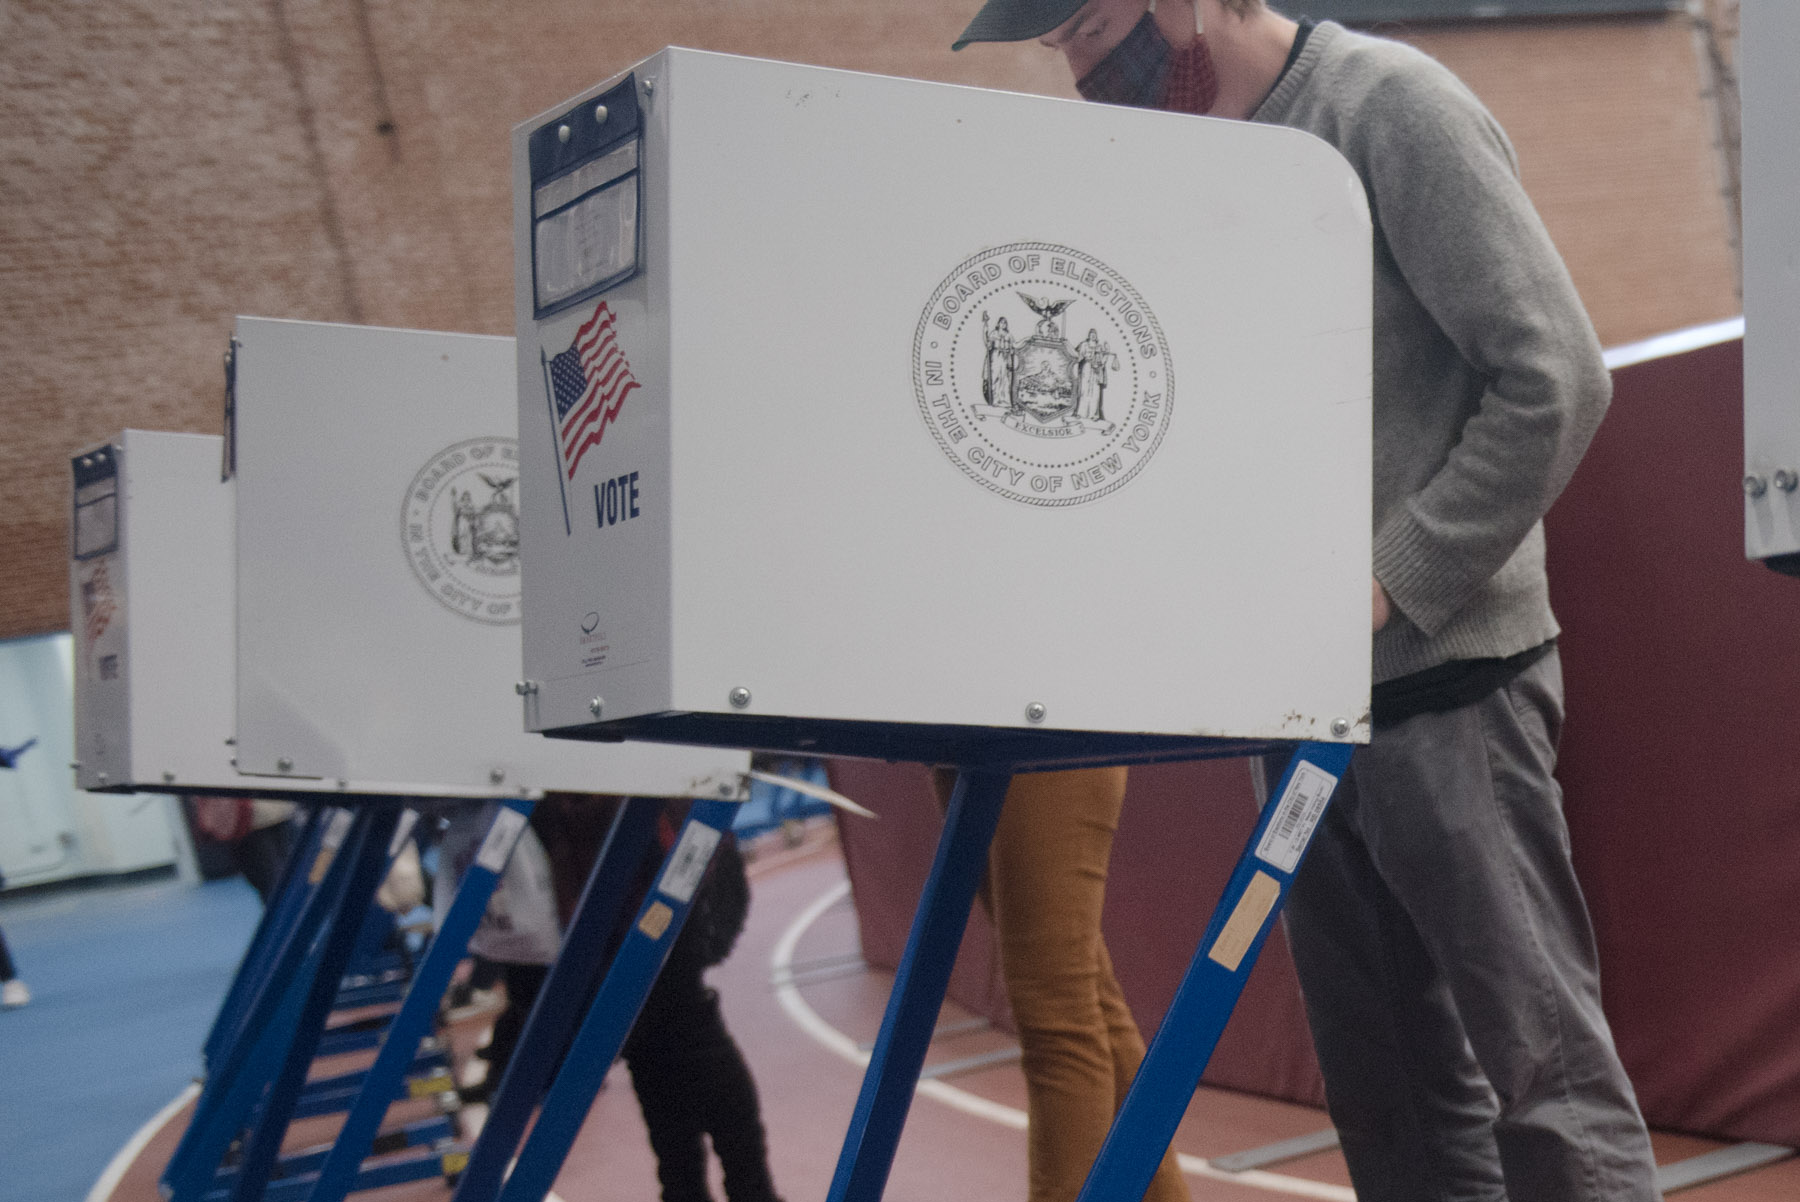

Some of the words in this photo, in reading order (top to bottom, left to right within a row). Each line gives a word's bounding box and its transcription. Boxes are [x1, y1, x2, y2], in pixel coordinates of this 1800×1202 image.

[933, 262, 1002, 330] BOARD
[1008, 254, 1041, 273] OF
[1050, 257, 1157, 360] ELECTIONS
[925, 360, 944, 386] IN
[933, 394, 968, 444] THE
[1015, 422, 1073, 437] EXCELSIOR
[1122, 391, 1161, 454] YORK
[415, 452, 466, 502] BOARD
[470, 445, 495, 460] OF
[967, 446, 1025, 486] CITY
[1031, 474, 1063, 493] OF
[1071, 452, 1124, 491] NEW
[592, 470, 641, 529] VOTE
[441, 583, 484, 611] CITY
[486, 601, 511, 615] OF
